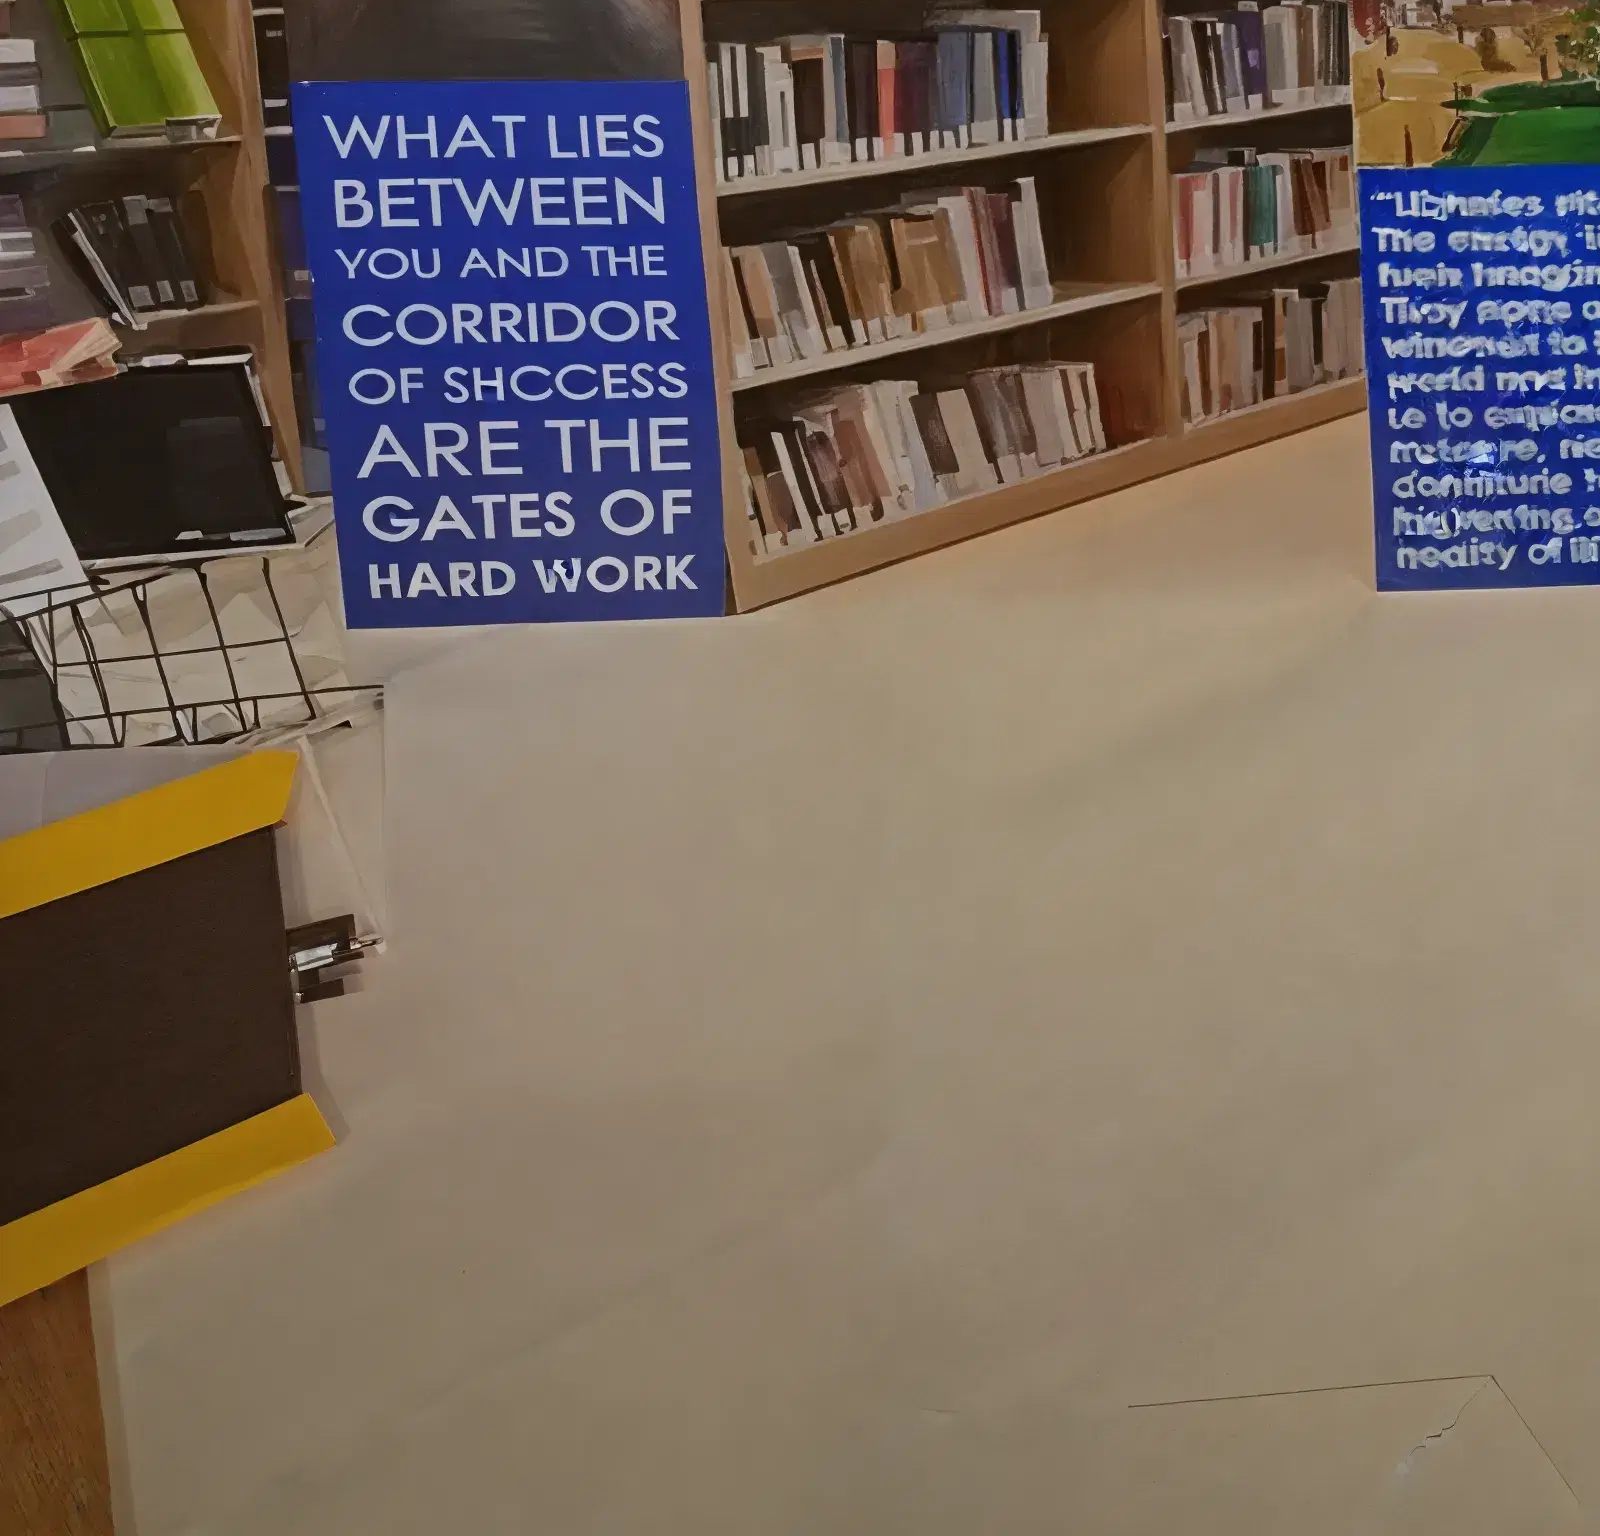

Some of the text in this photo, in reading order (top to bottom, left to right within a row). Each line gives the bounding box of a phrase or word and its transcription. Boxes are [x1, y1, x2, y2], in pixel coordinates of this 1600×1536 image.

[322, 114, 665, 160] WHAT LIES
[334, 176, 666, 228] BETWEEN
[334, 244, 668, 279] YOU AND THE
[342, 300, 681, 347] CORRIDOR
[348, 367, 424, 405] OF
[356, 416, 692, 479] ARE THE
[362, 488, 693, 543] GATES OF
[368, 554, 699, 599] HARD WORK
